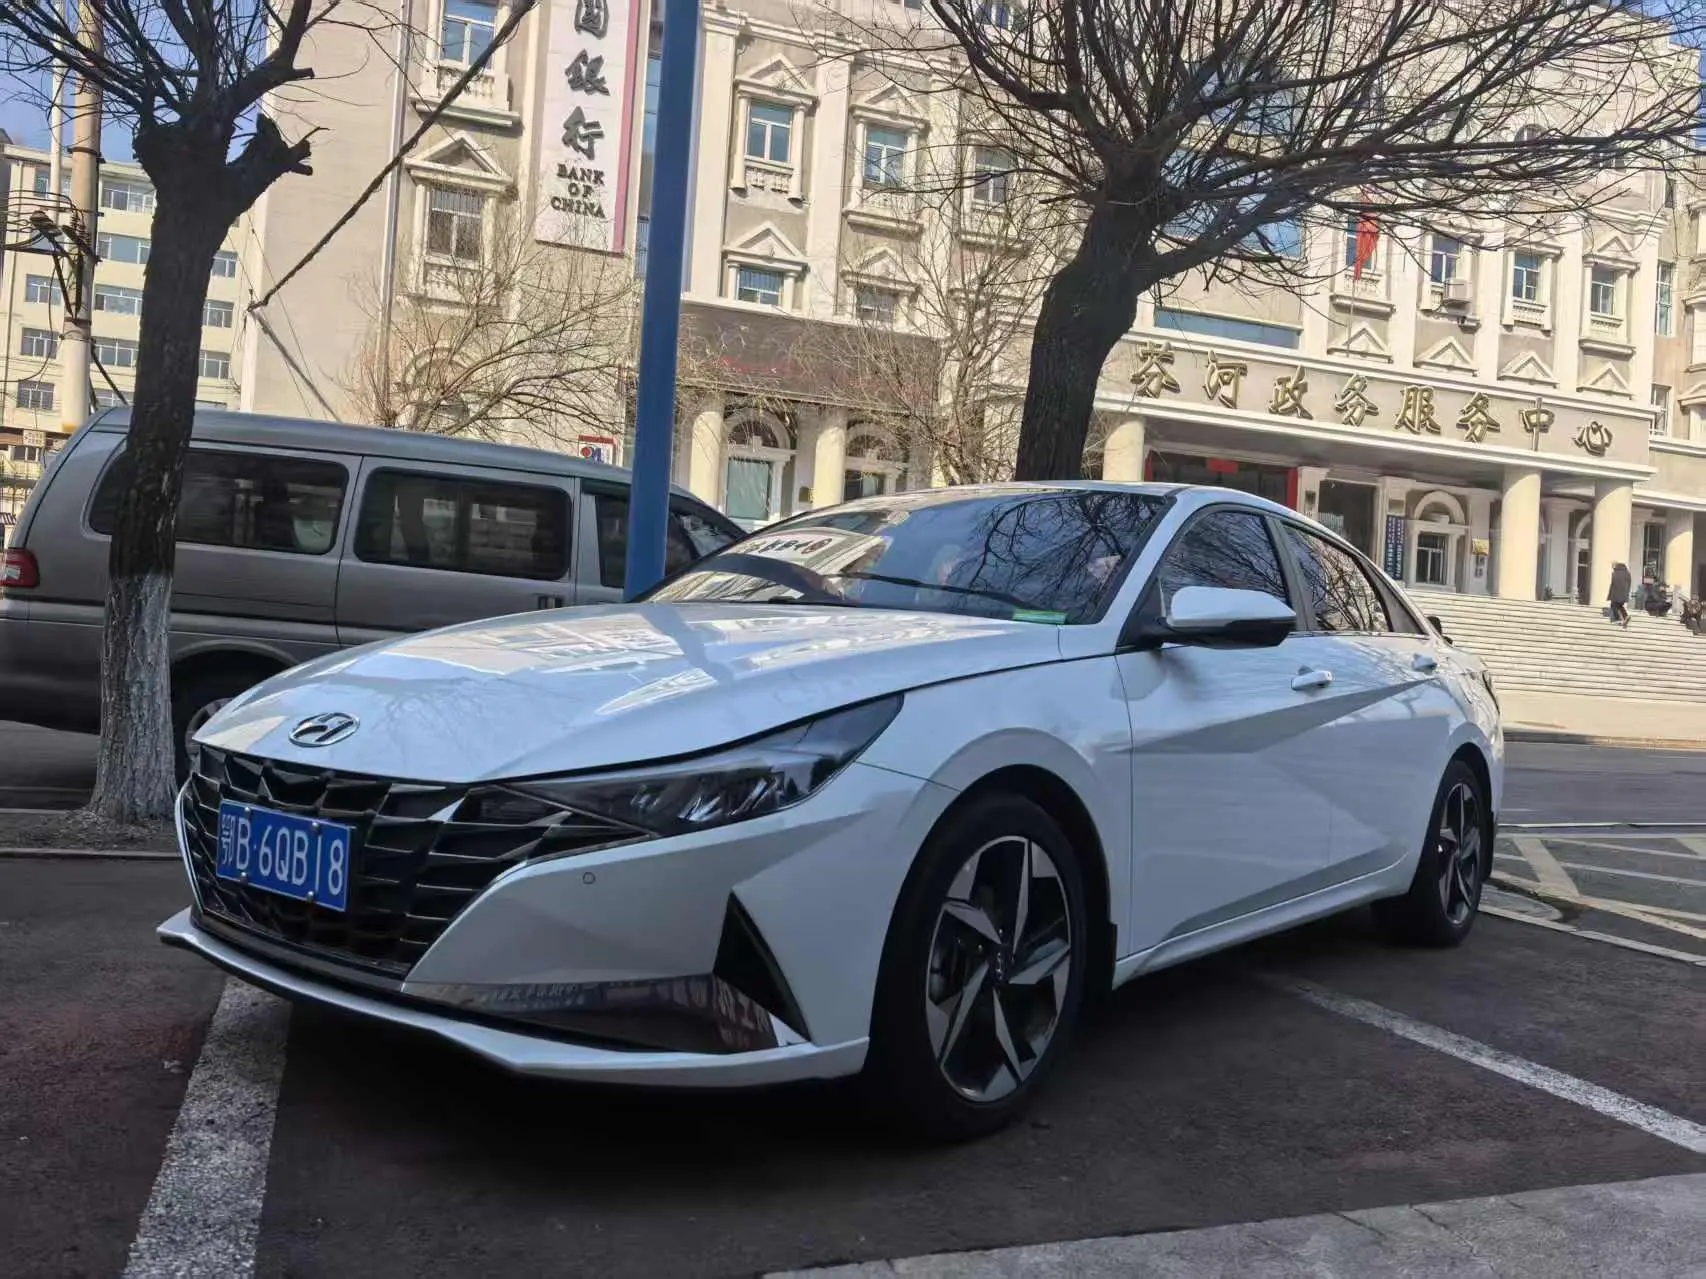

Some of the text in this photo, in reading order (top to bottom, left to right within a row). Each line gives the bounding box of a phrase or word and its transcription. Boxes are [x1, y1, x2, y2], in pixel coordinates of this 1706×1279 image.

[557, 163, 605, 186] BANK
[568, 183, 594, 198] OF
[551, 196, 606, 219] CHINA
[1130, 340, 1613, 457] 芬河政务服务中心
